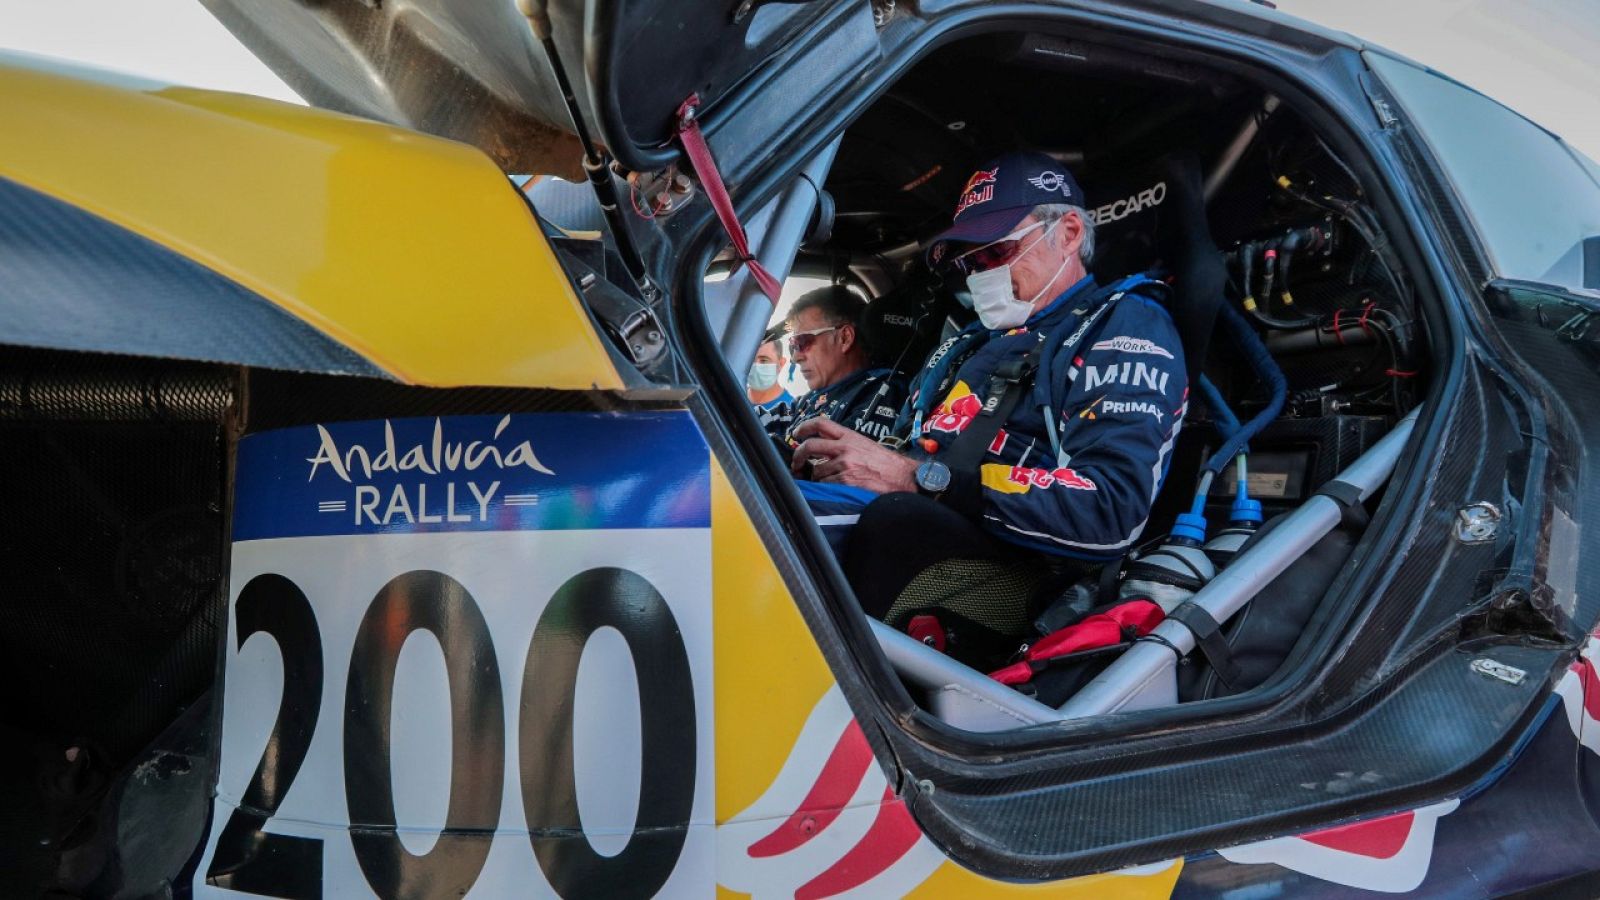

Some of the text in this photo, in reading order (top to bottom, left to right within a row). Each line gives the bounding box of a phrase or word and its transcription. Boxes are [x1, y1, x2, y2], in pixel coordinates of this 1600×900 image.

[884, 314, 914, 328] RECA
[1085, 361, 1170, 396] MINI
[855, 418, 891, 440] MIN
[1102, 400, 1164, 424] PRIMAX
[306, 413, 556, 483] Andalucía
[354, 480, 501, 525] RALLY
[206, 566, 697, 900] 200
